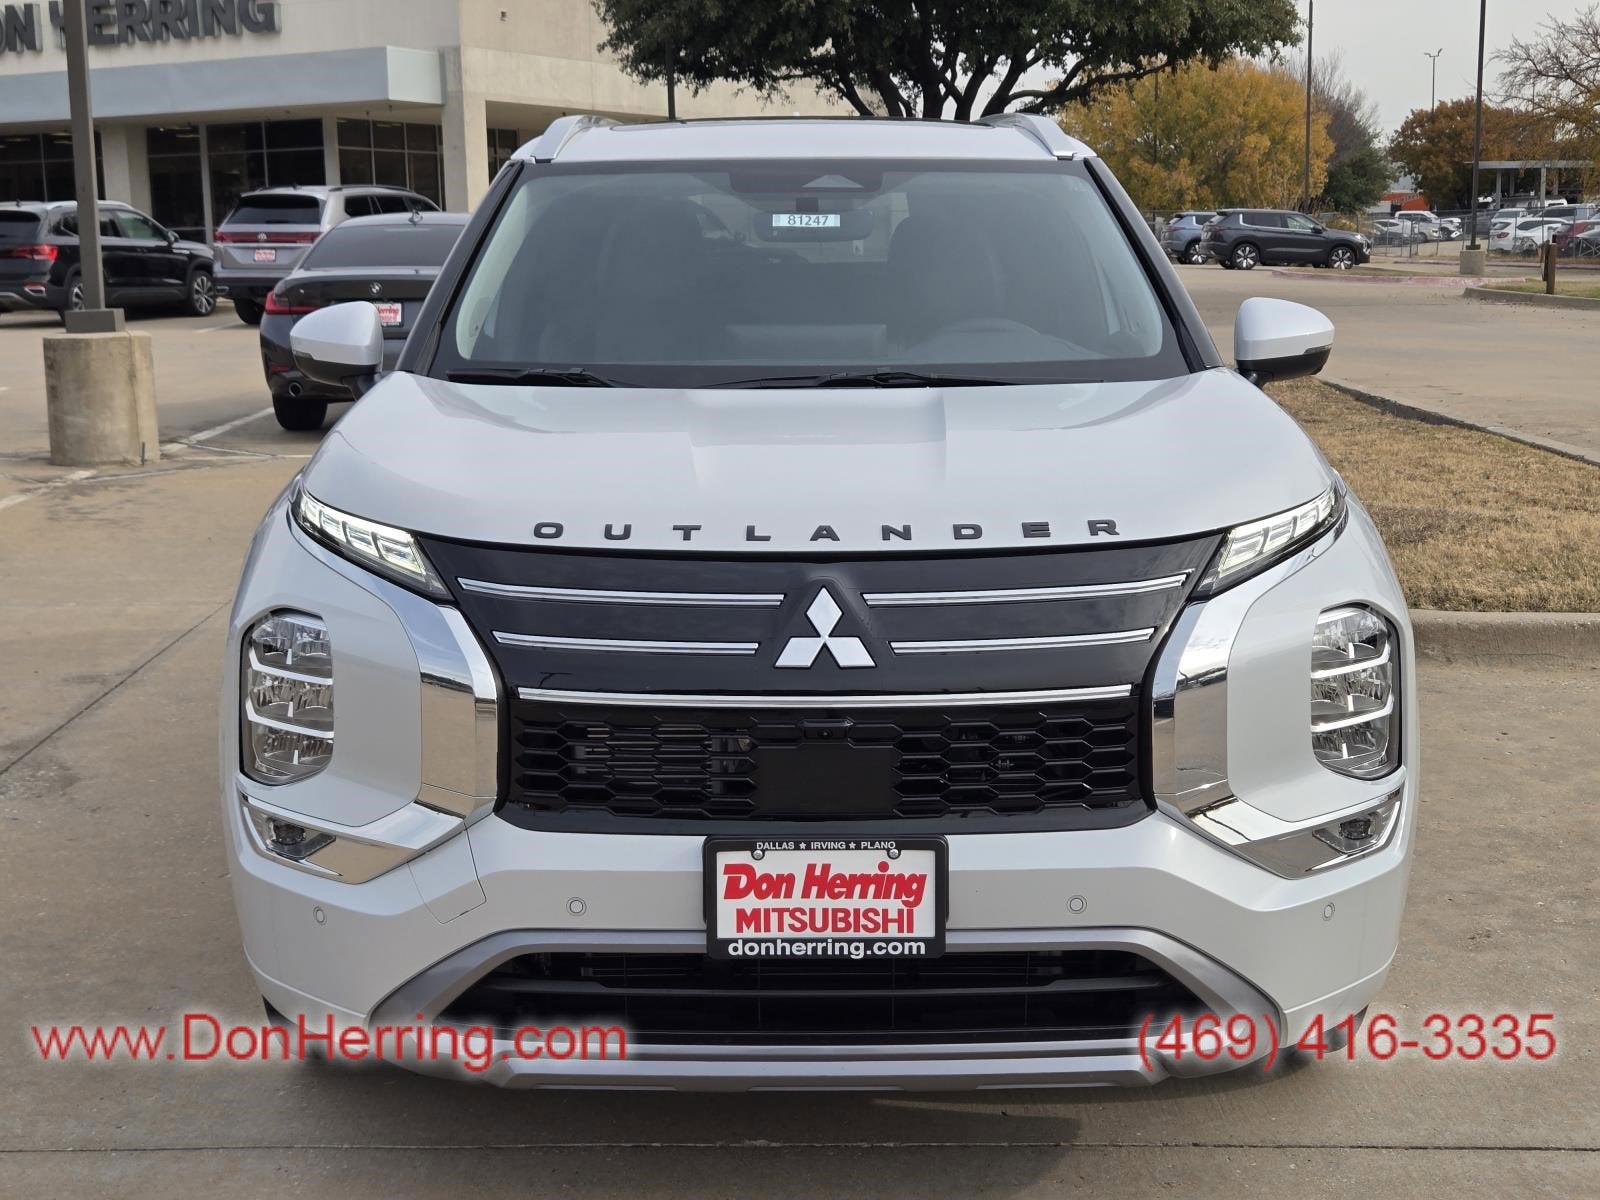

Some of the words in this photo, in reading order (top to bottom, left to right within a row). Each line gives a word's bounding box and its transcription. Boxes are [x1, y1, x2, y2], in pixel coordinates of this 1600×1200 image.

[0, 3, 42, 53] N
[787, 215, 829, 226] 81247
[533, 519, 1121, 543] OUTLANDER
[756, 841, 795, 850] DALLAS
[810, 841, 846, 850] IRVING
[860, 841, 896, 850] PLANO
[722, 863, 796, 901] Don
[800, 860, 928, 909] Herring
[735, 907, 915, 934] MITSUBISHI
[727, 939, 926, 959] donherring.com
